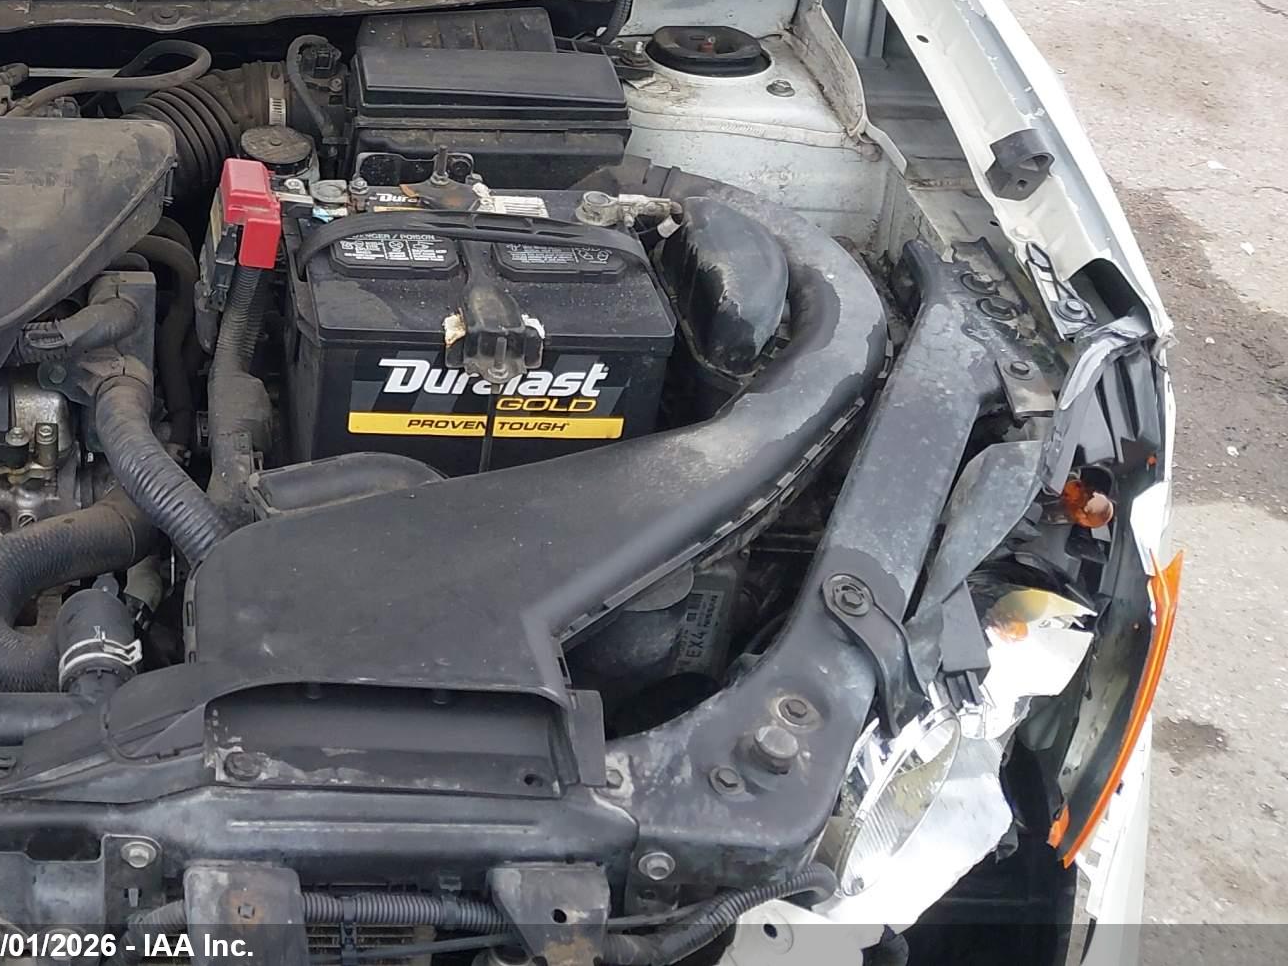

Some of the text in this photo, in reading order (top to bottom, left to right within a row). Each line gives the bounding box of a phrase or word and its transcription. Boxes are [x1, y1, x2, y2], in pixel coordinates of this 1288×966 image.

[496, 397, 597, 412] GOLD
[407, 419, 568, 431] PROVEN TOUGH
[686, 631, 707, 658] EX4
